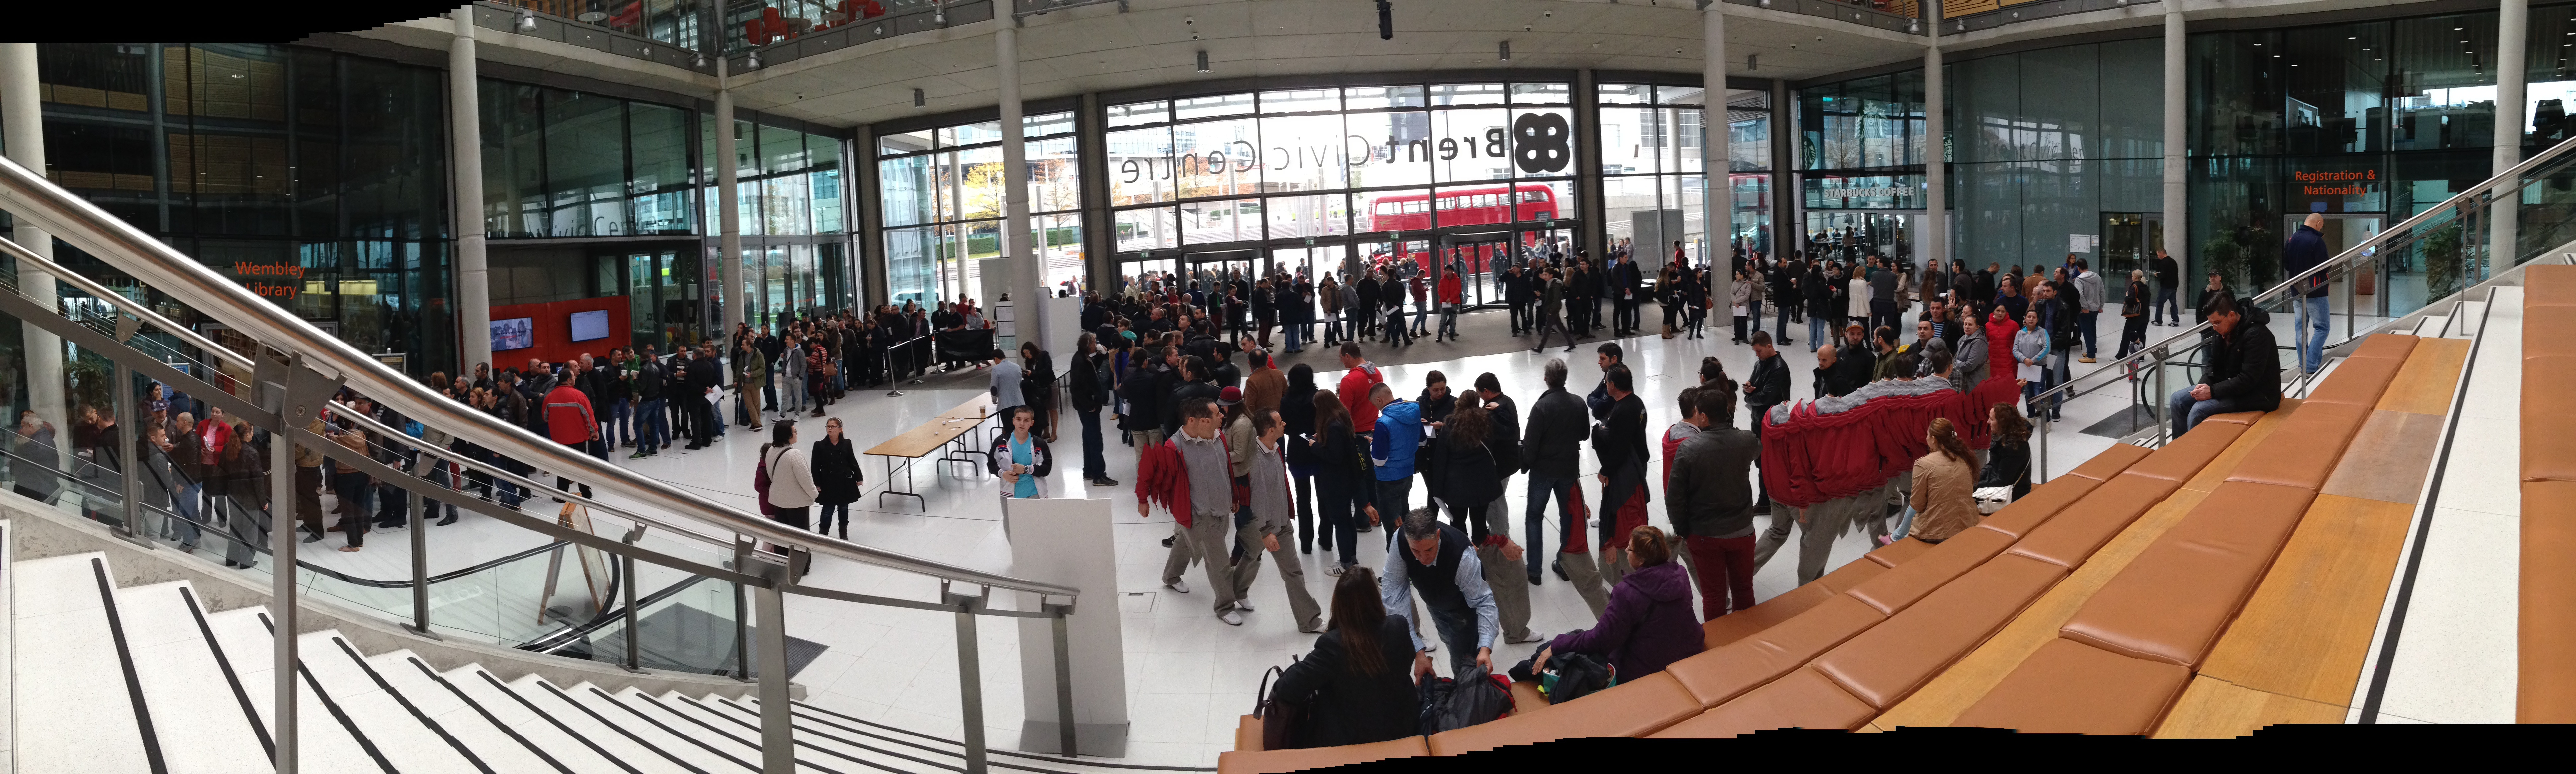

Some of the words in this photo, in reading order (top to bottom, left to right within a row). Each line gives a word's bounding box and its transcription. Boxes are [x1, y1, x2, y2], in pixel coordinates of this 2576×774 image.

[2296, 170, 2363, 183] Registration
[2367, 169, 2375, 180] &
[1825, 187, 1876, 197] STARBUCKS
[1879, 187, 1914, 197] COFFEE
[2304, 185, 2366, 197] Nationality
[235, 261, 306, 279] Wembley
